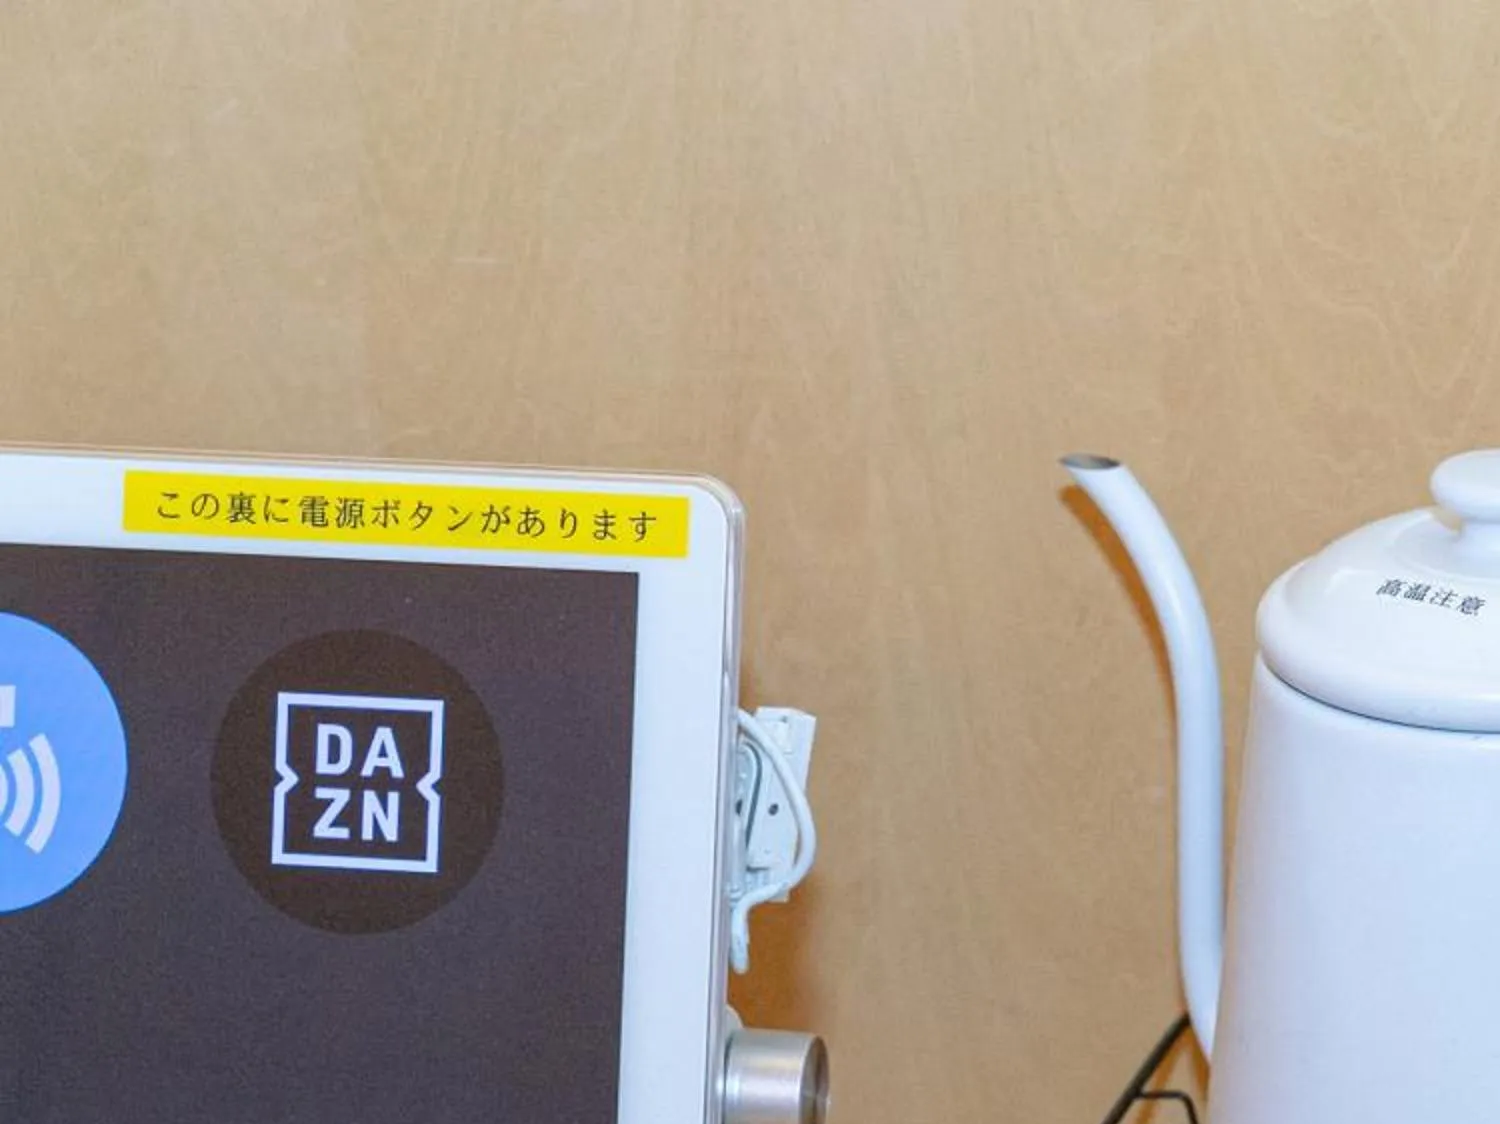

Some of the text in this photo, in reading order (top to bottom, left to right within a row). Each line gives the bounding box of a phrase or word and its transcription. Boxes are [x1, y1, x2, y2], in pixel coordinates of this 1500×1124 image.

[157, 491, 656, 542] この裏に電源ボタンがあります
[1376, 579, 1486, 616] 高温注意
